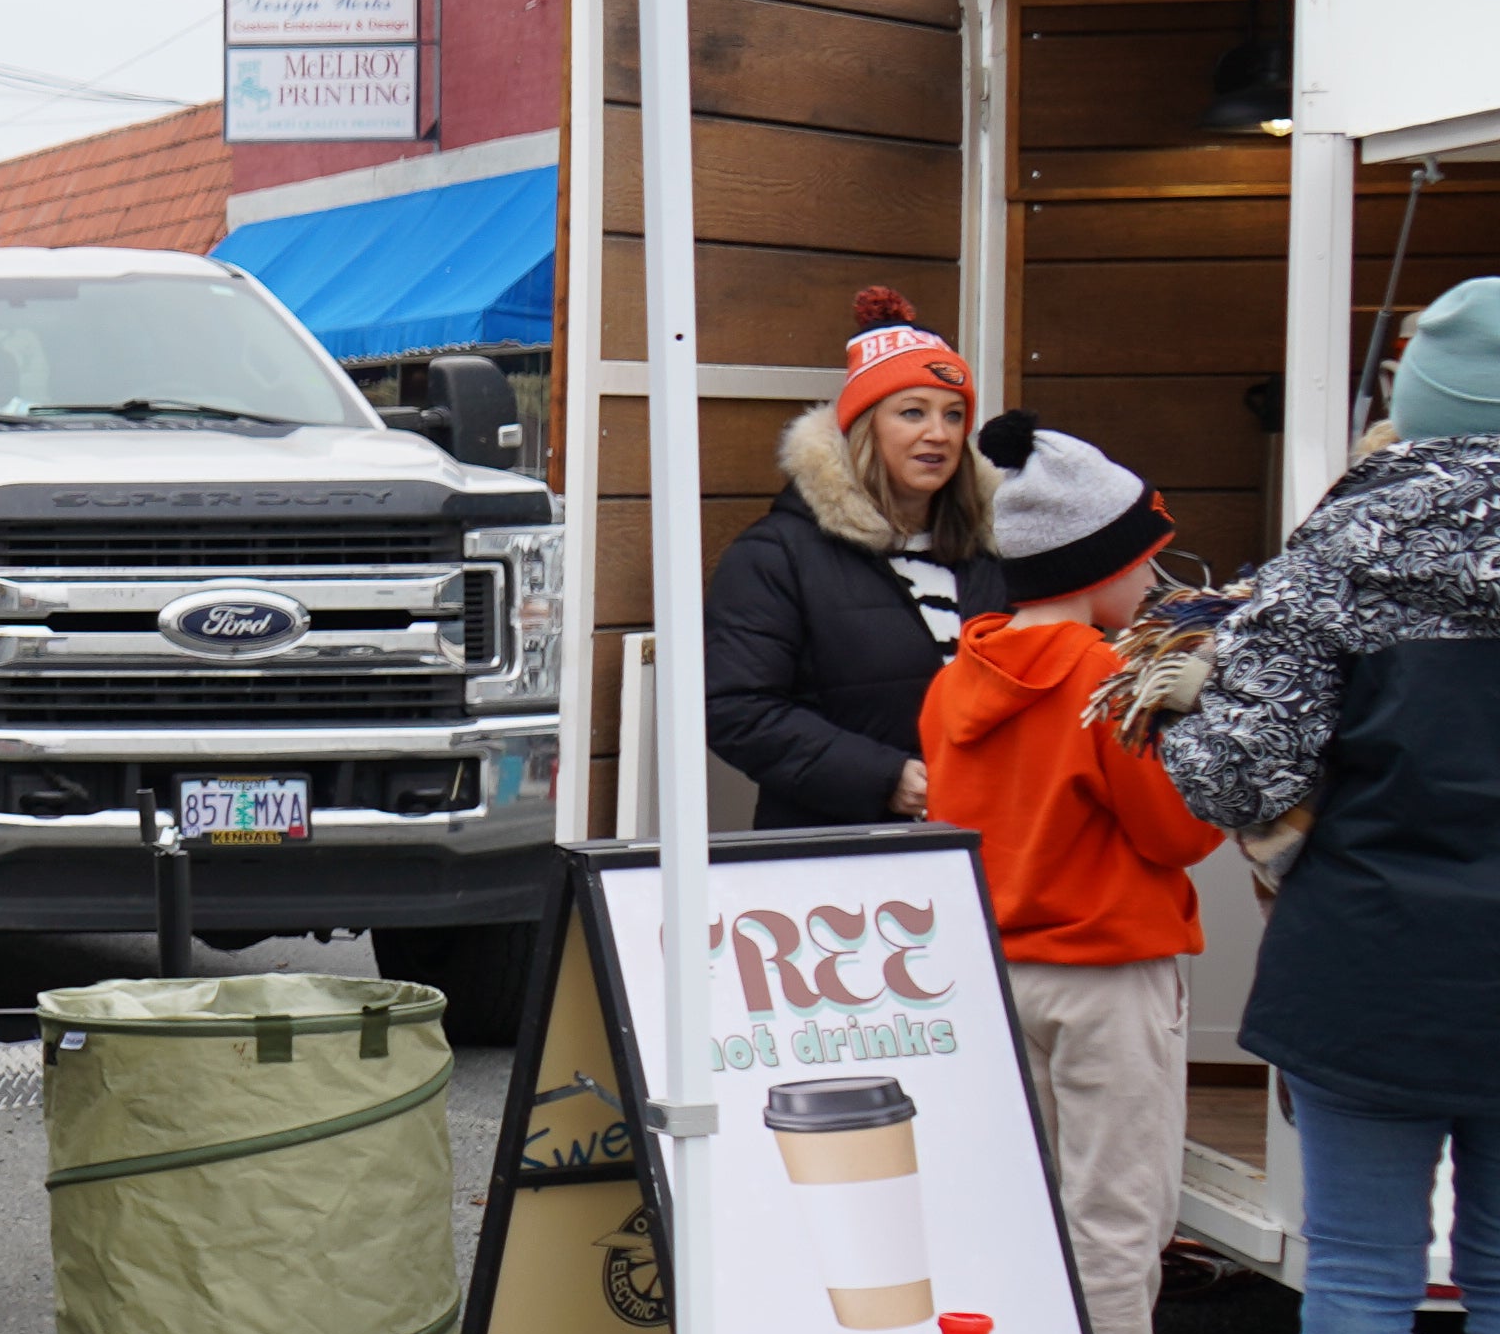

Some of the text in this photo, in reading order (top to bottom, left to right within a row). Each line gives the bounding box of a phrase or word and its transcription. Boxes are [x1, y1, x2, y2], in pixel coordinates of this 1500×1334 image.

[284, 49, 406, 80] McELROY
[278, 82, 411, 108] PRINTING
[51, 488, 394, 508] SUPER DUTY
[201, 605, 273, 636] Ford
[185, 792, 303, 827] 857 MXA
[212, 831, 282, 844] KENDALL
[790, 1014, 959, 1066] drinks
[610, 1258, 658, 1322] ELECTRIC
